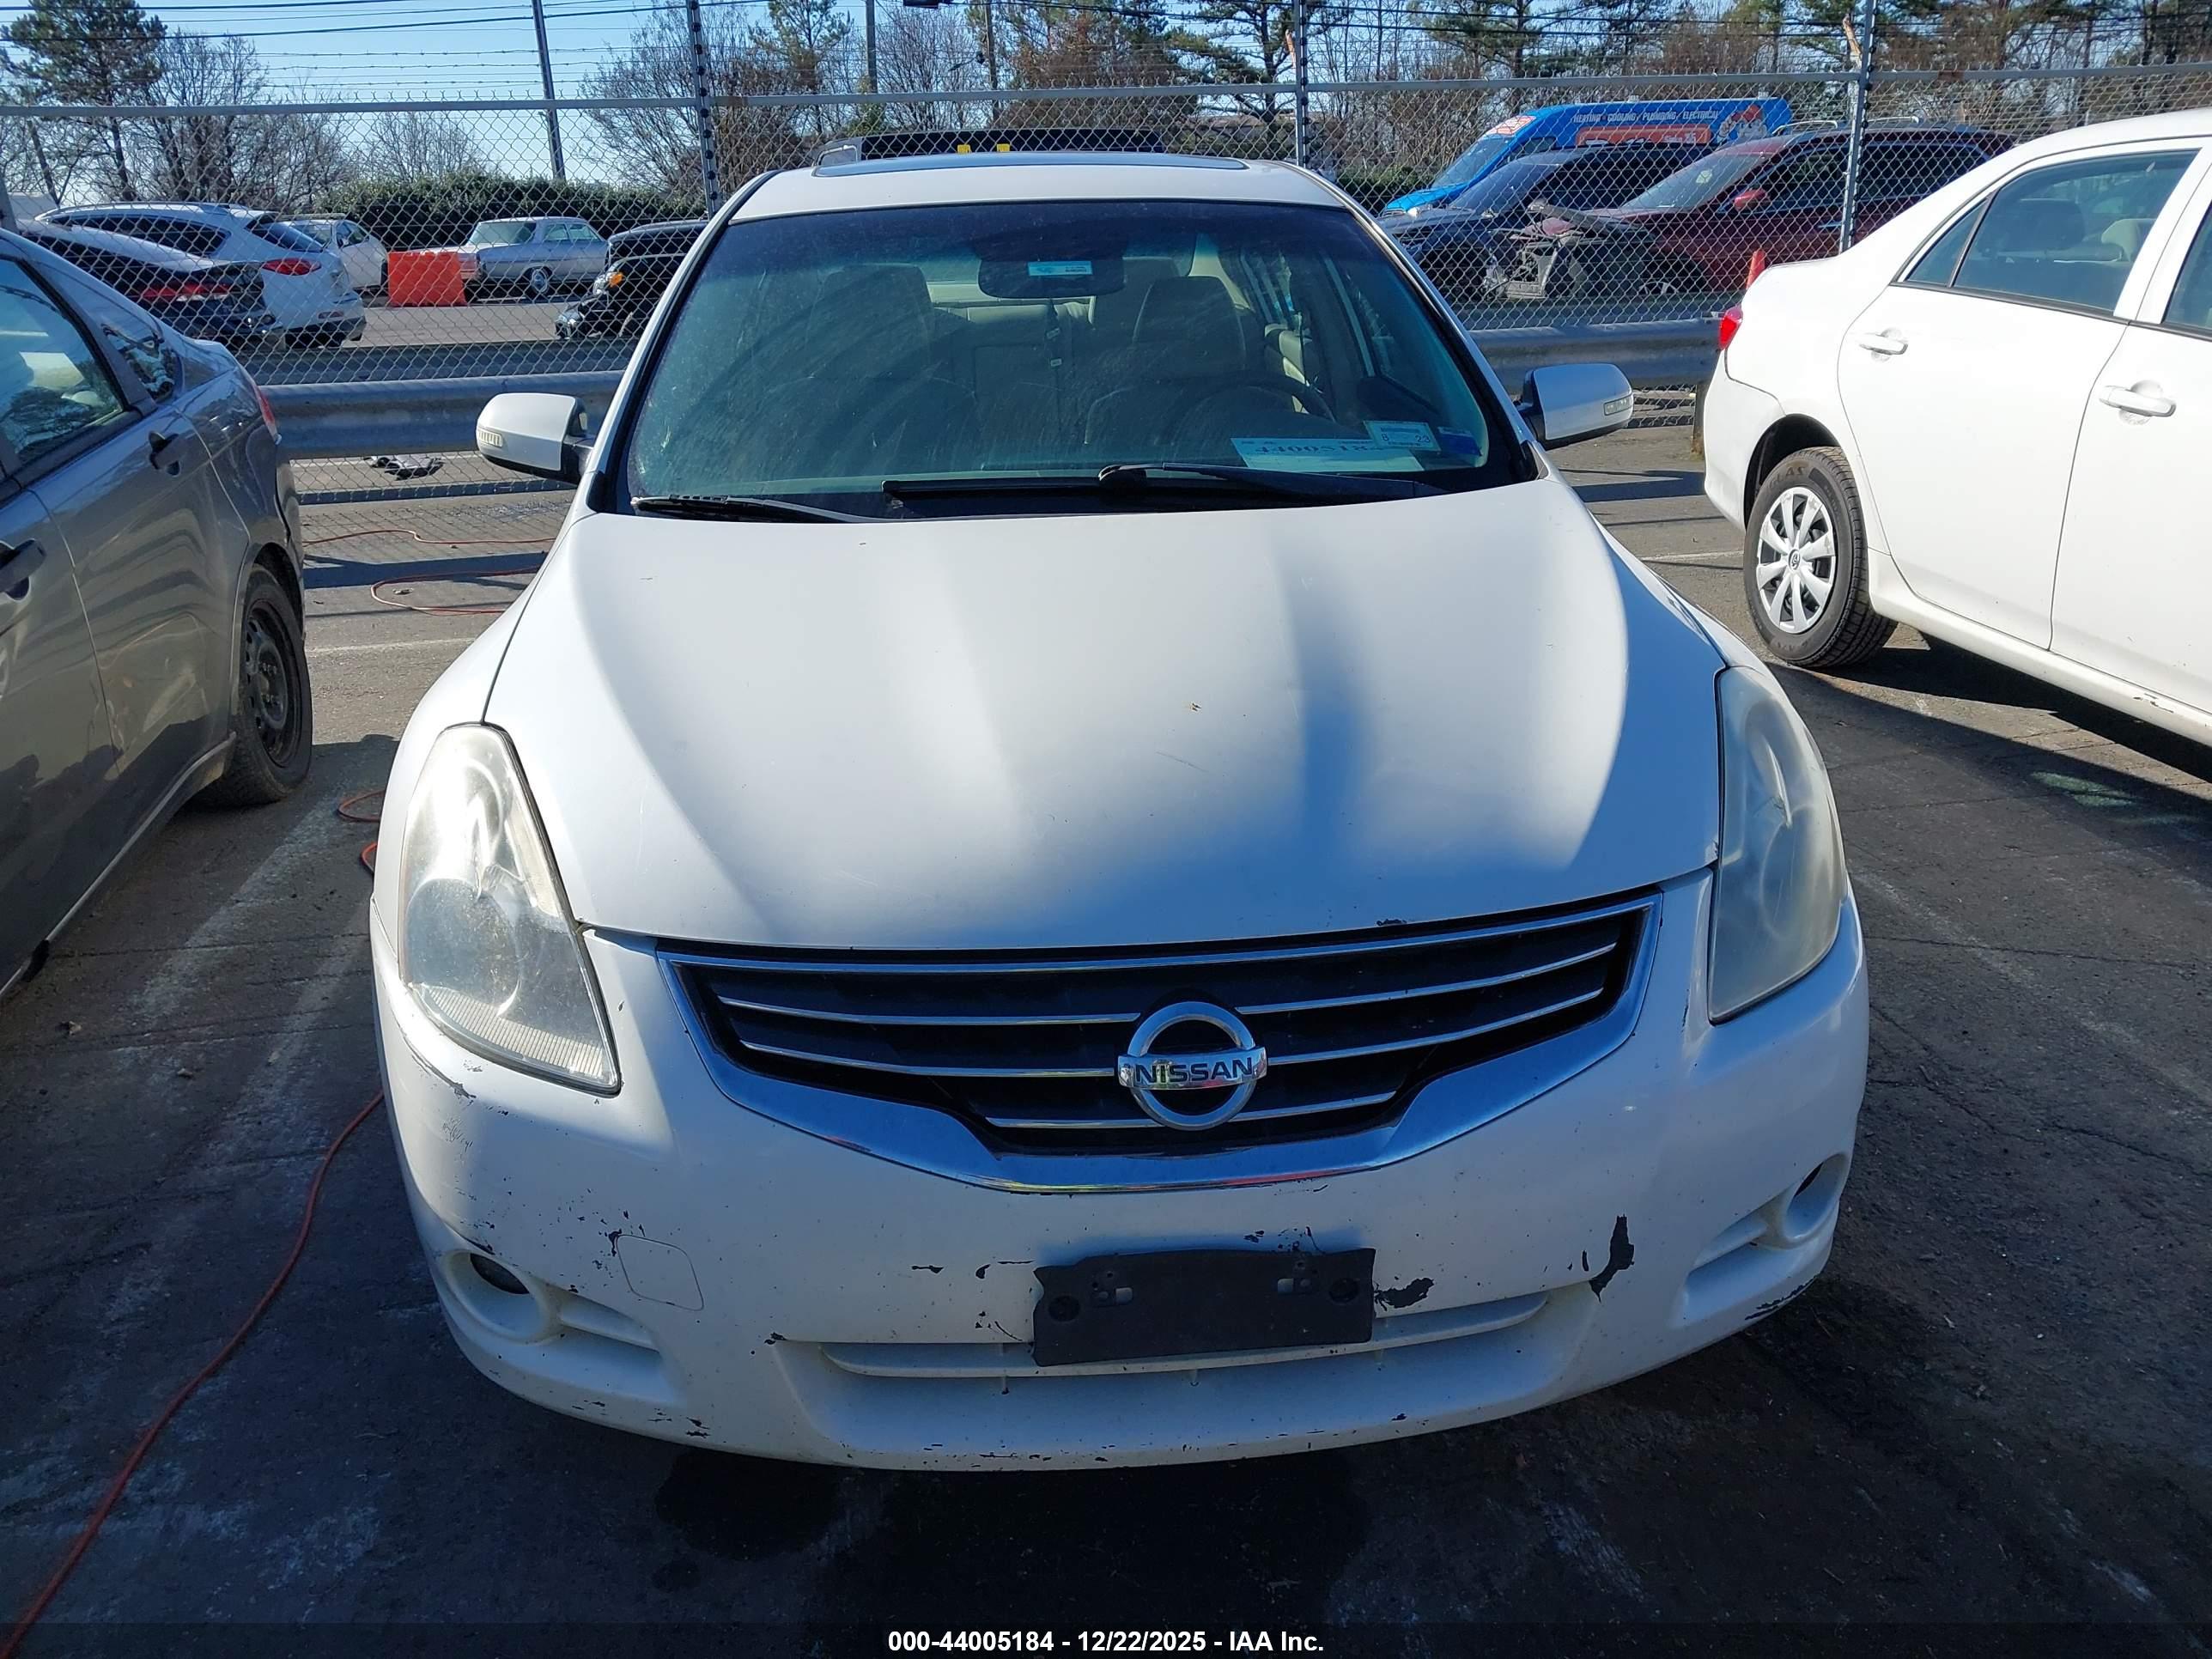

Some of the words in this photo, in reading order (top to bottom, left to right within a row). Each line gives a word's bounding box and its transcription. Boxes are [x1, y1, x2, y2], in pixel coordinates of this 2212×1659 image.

[1573, 112, 1601, 123] HEATING
[1607, 112, 1637, 122] COOLING
[1642, 111, 1676, 121] PLUMBING
[1682, 110, 1718, 119] ELECTRICAL
[1134, 1056, 1252, 1084] NISSAN
